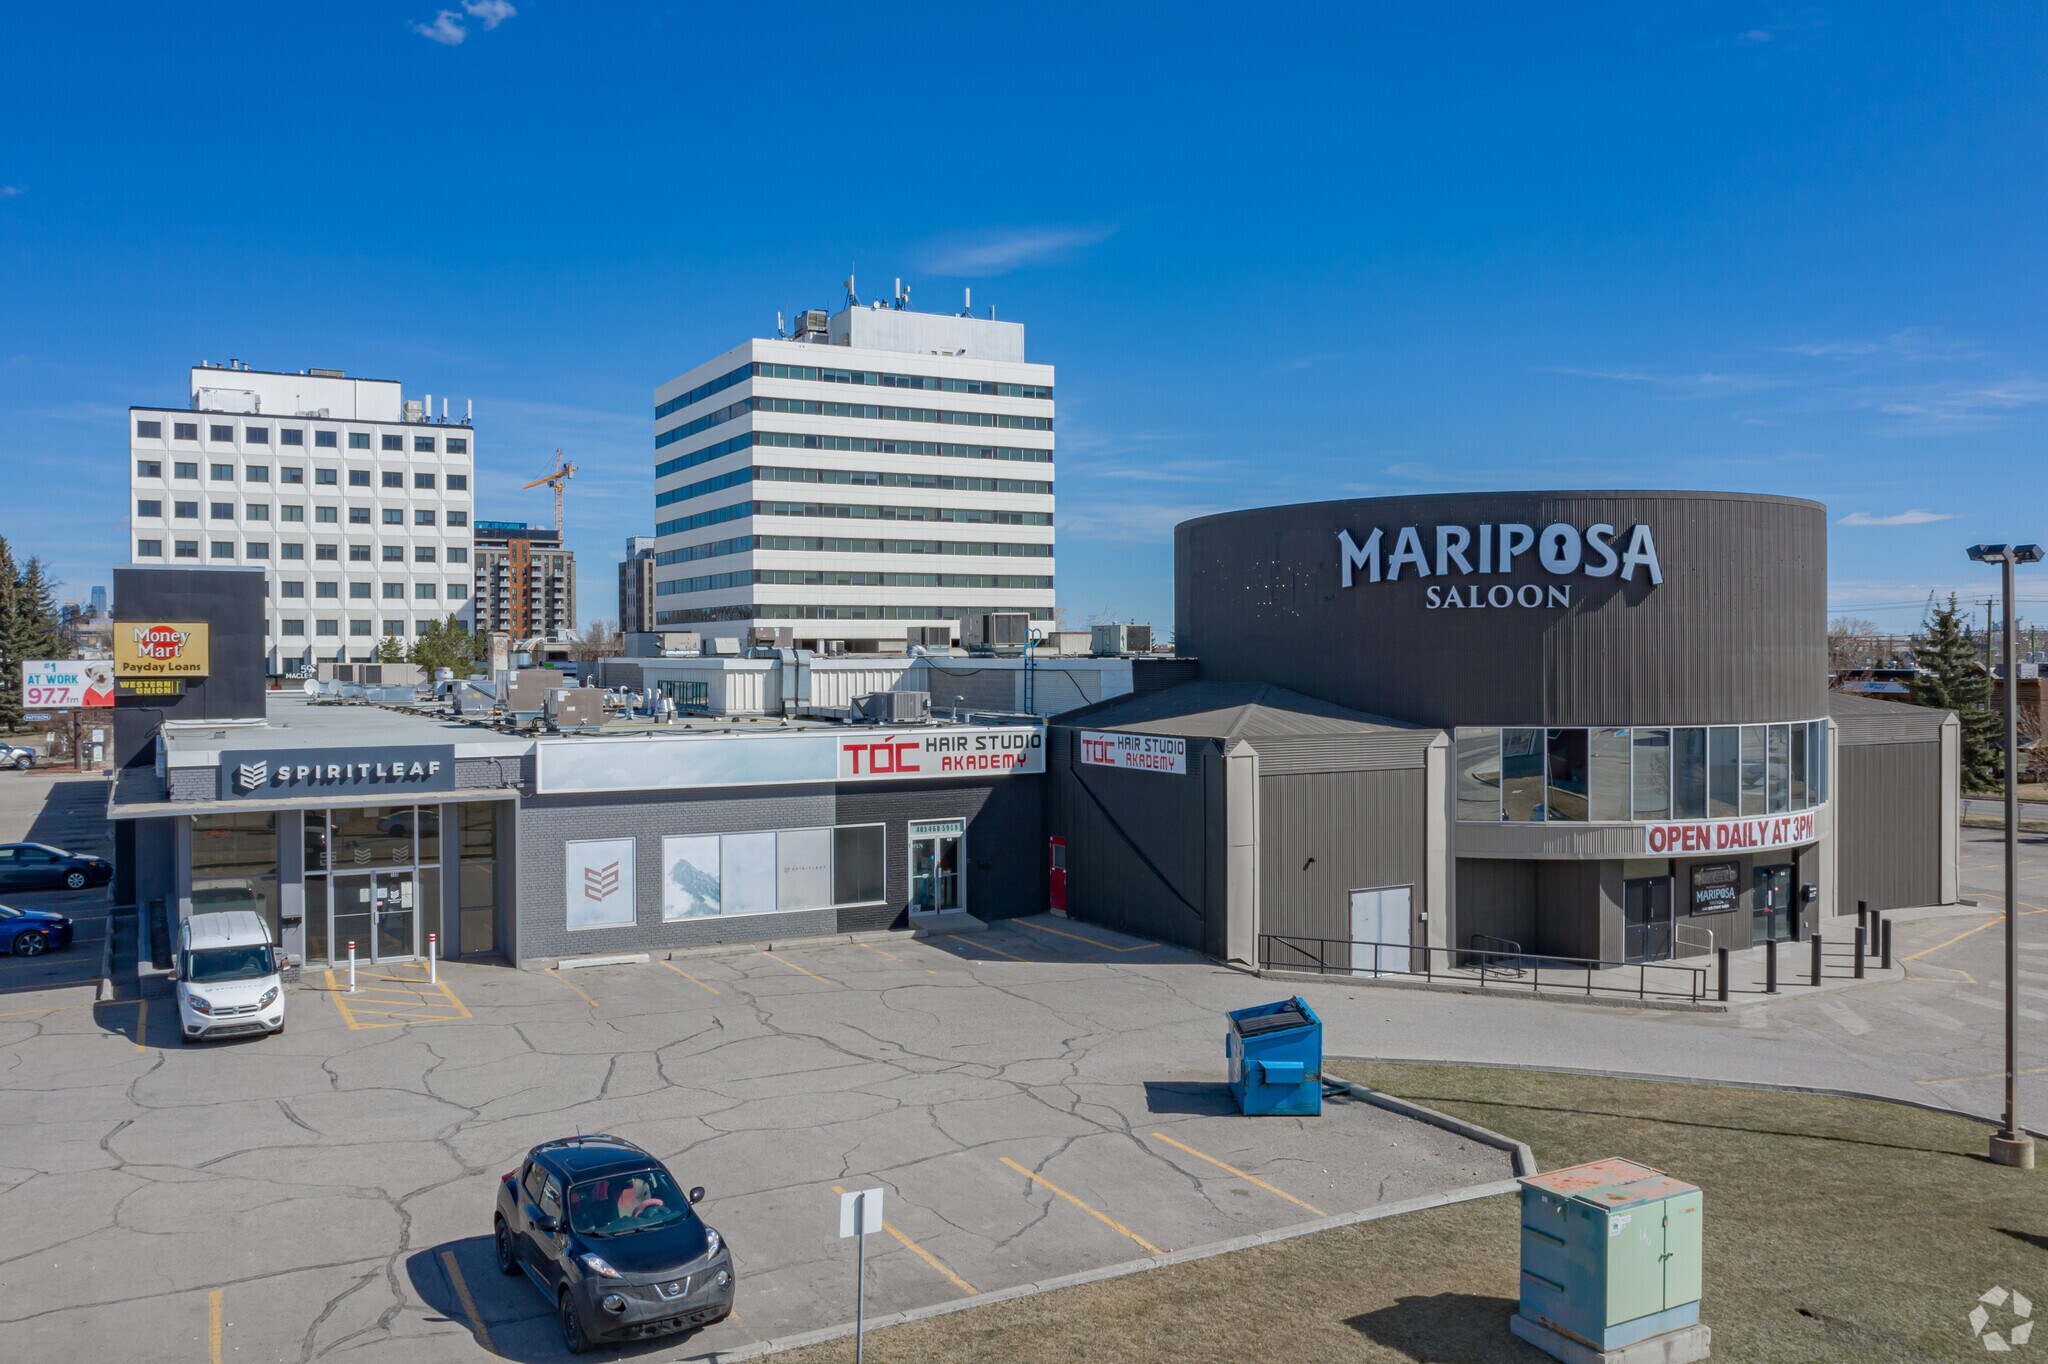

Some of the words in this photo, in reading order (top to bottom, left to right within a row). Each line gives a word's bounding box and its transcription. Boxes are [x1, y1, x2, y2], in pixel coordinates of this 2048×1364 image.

[1338, 522, 1664, 588] MARIPOSA
[1426, 584, 1571, 609] SALOON
[133, 627, 191, 647] Money
[138, 643, 182, 658] Mart
[44, 663, 56, 672] #1
[123, 662, 165, 672] Payday
[168, 662, 201, 671] Loans
[28, 675, 40, 684] AT
[46, 675, 79, 684] WORK
[28, 687, 70, 704] 97.7
[925, 737, 968, 752] HAIR
[975, 734, 1042, 750] STUDIO
[1117, 736, 1140, 751] HAIR
[1145, 738, 1184, 755] STUDIO
[942, 753, 1027, 771] AKADEMY
[1126, 752, 1175, 770] AKADEMY
[278, 761, 440, 780] SPIRITLEAF
[1649, 824, 1711, 853] OPEN
[1717, 820, 1770, 850] DAILY
[1772, 818, 1791, 845] AT
[1793, 814, 1813, 842] 3PM
[1696, 887, 1735, 903] MARIPOSA
